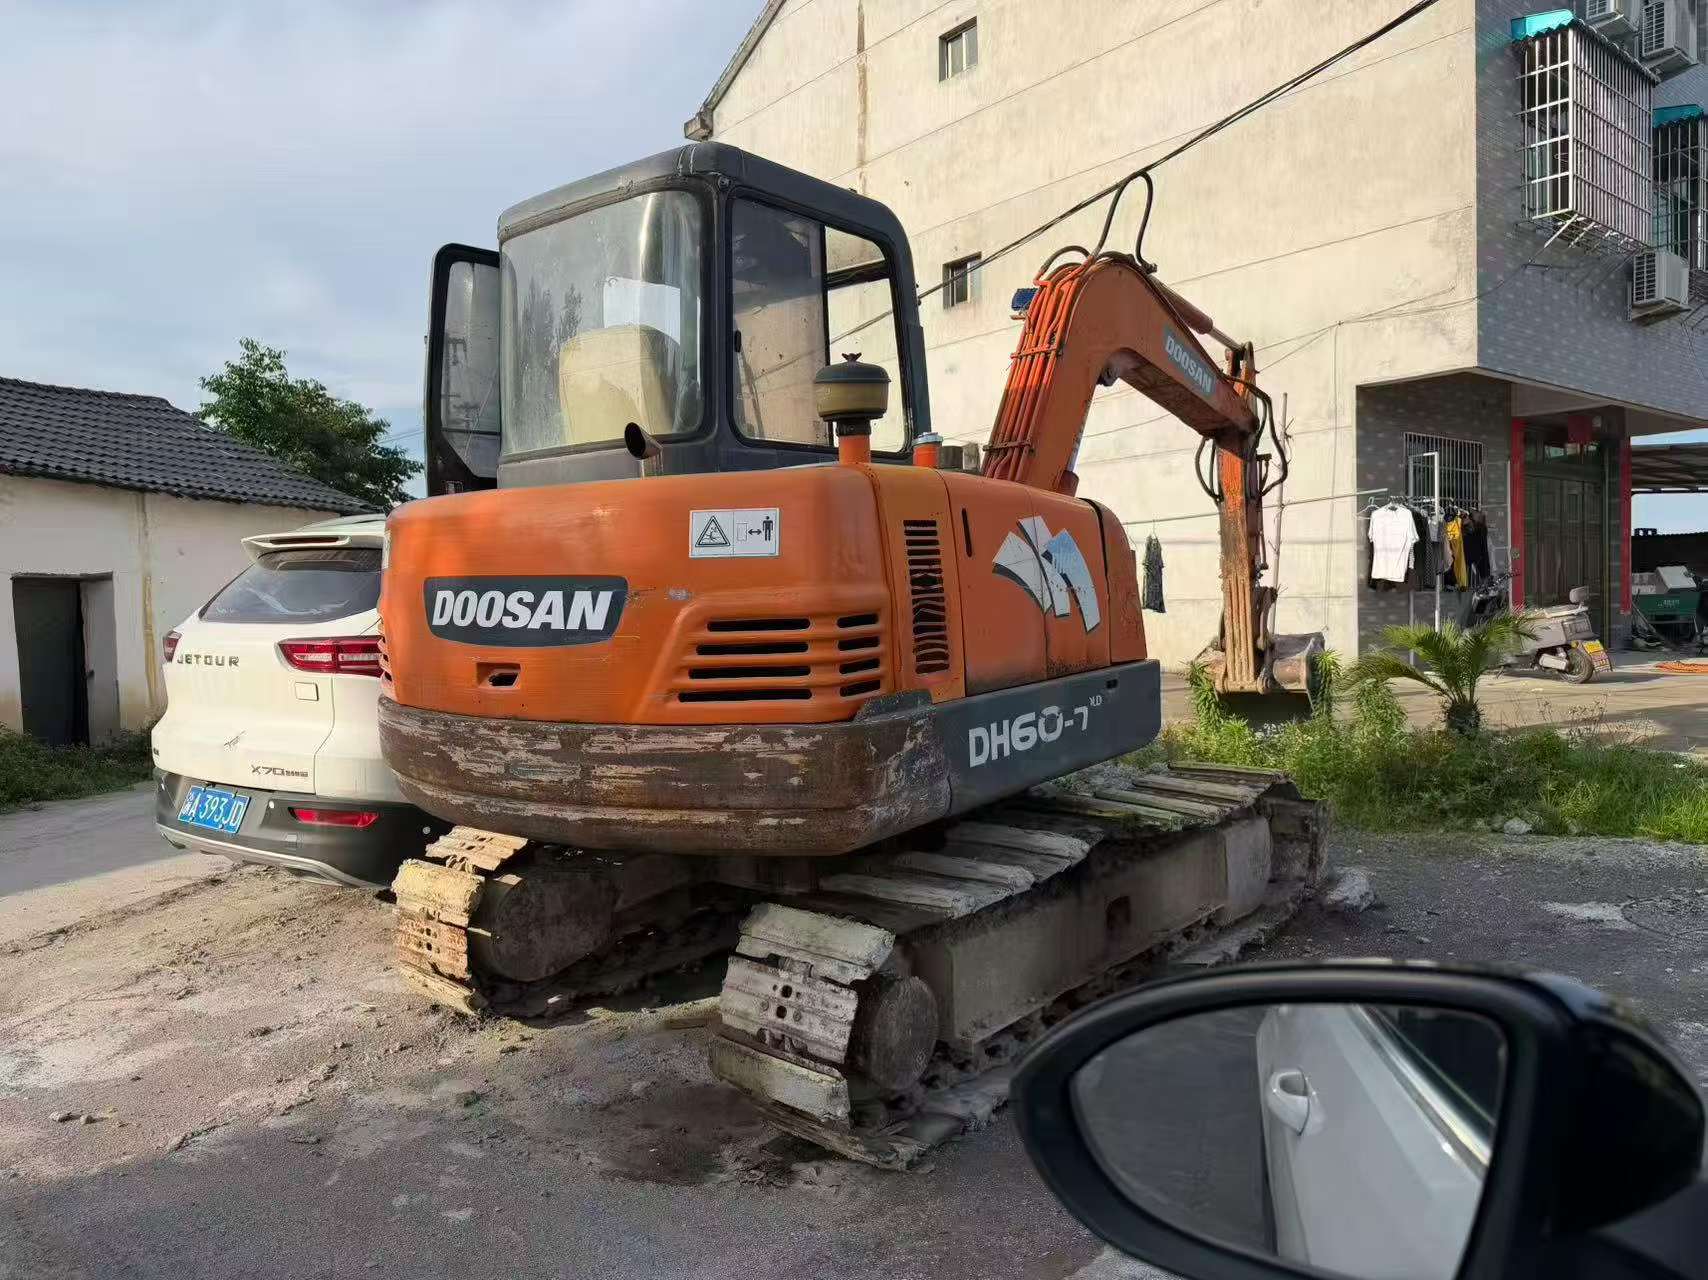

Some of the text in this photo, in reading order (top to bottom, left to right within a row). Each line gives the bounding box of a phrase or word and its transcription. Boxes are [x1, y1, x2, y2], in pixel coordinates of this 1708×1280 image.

[1166, 335, 1213, 393] DOOSAN
[432, 589, 614, 631] DOOSAN
[177, 653, 240, 667] JETOUR
[968, 705, 1089, 768] DH60-7
